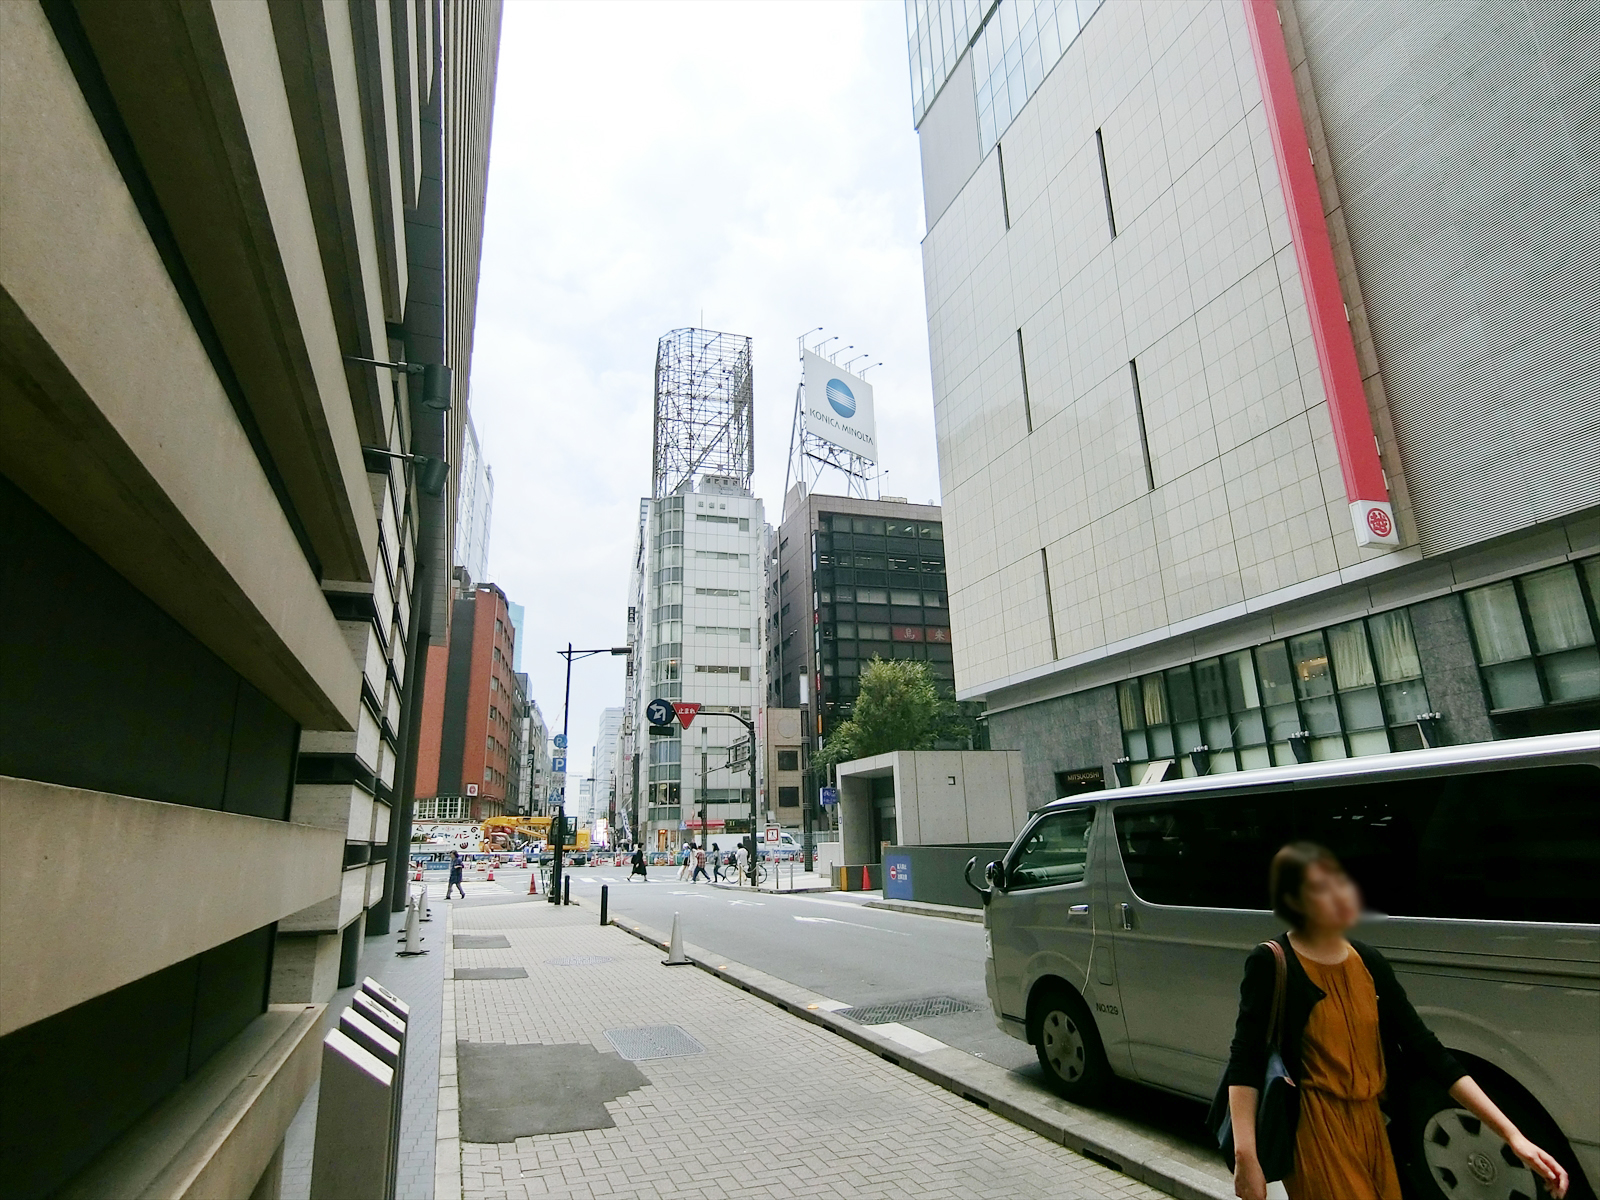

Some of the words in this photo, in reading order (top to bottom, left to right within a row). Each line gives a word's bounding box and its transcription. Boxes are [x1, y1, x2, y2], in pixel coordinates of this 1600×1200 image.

[809, 408, 841, 430] KONICA
[841, 423, 874, 446] MINOLTA
[678, 707, 696, 715] 止まれ
[556, 737, 563, 747] P
[555, 758, 565, 771] P
[1067, 771, 1100, 781] MITSUKOSHI
